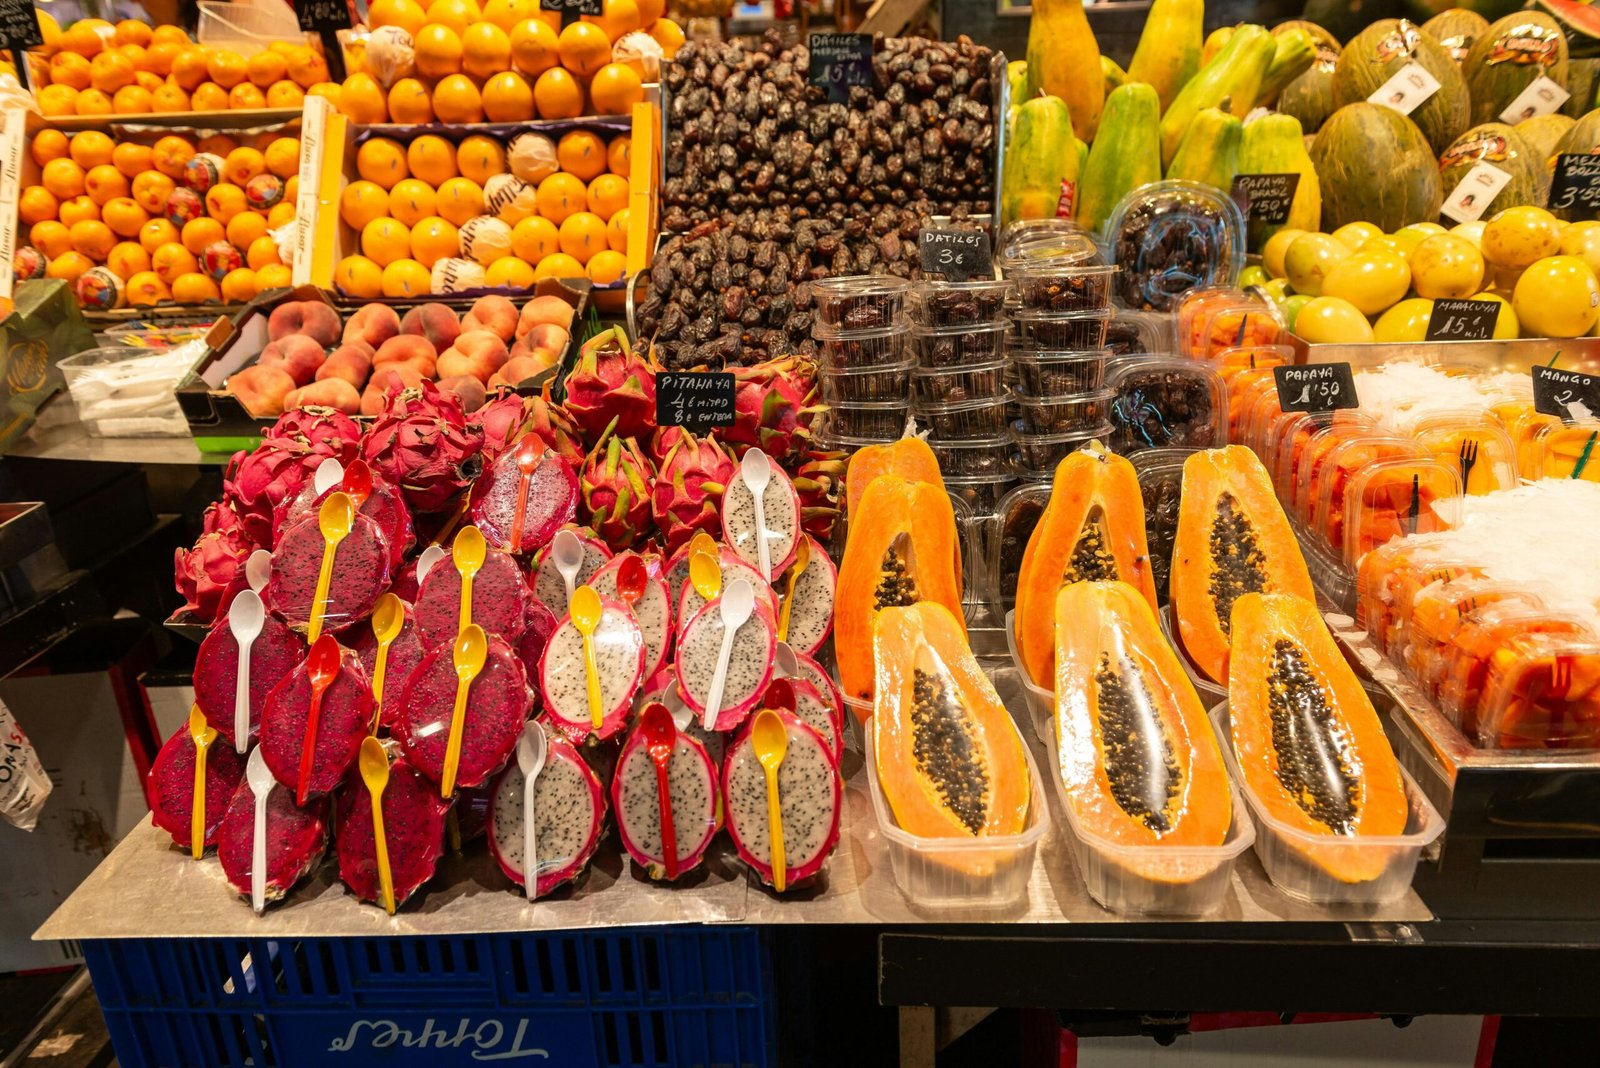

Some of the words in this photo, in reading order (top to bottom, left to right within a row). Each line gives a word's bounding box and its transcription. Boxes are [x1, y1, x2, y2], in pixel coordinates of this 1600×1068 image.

[1239, 176, 1286, 190] PAPAYA
[1286, 367, 1333, 381] PAPAYA
[1540, 370, 1591, 385] MANGO
[327, 1018, 549, 1061] Torres
